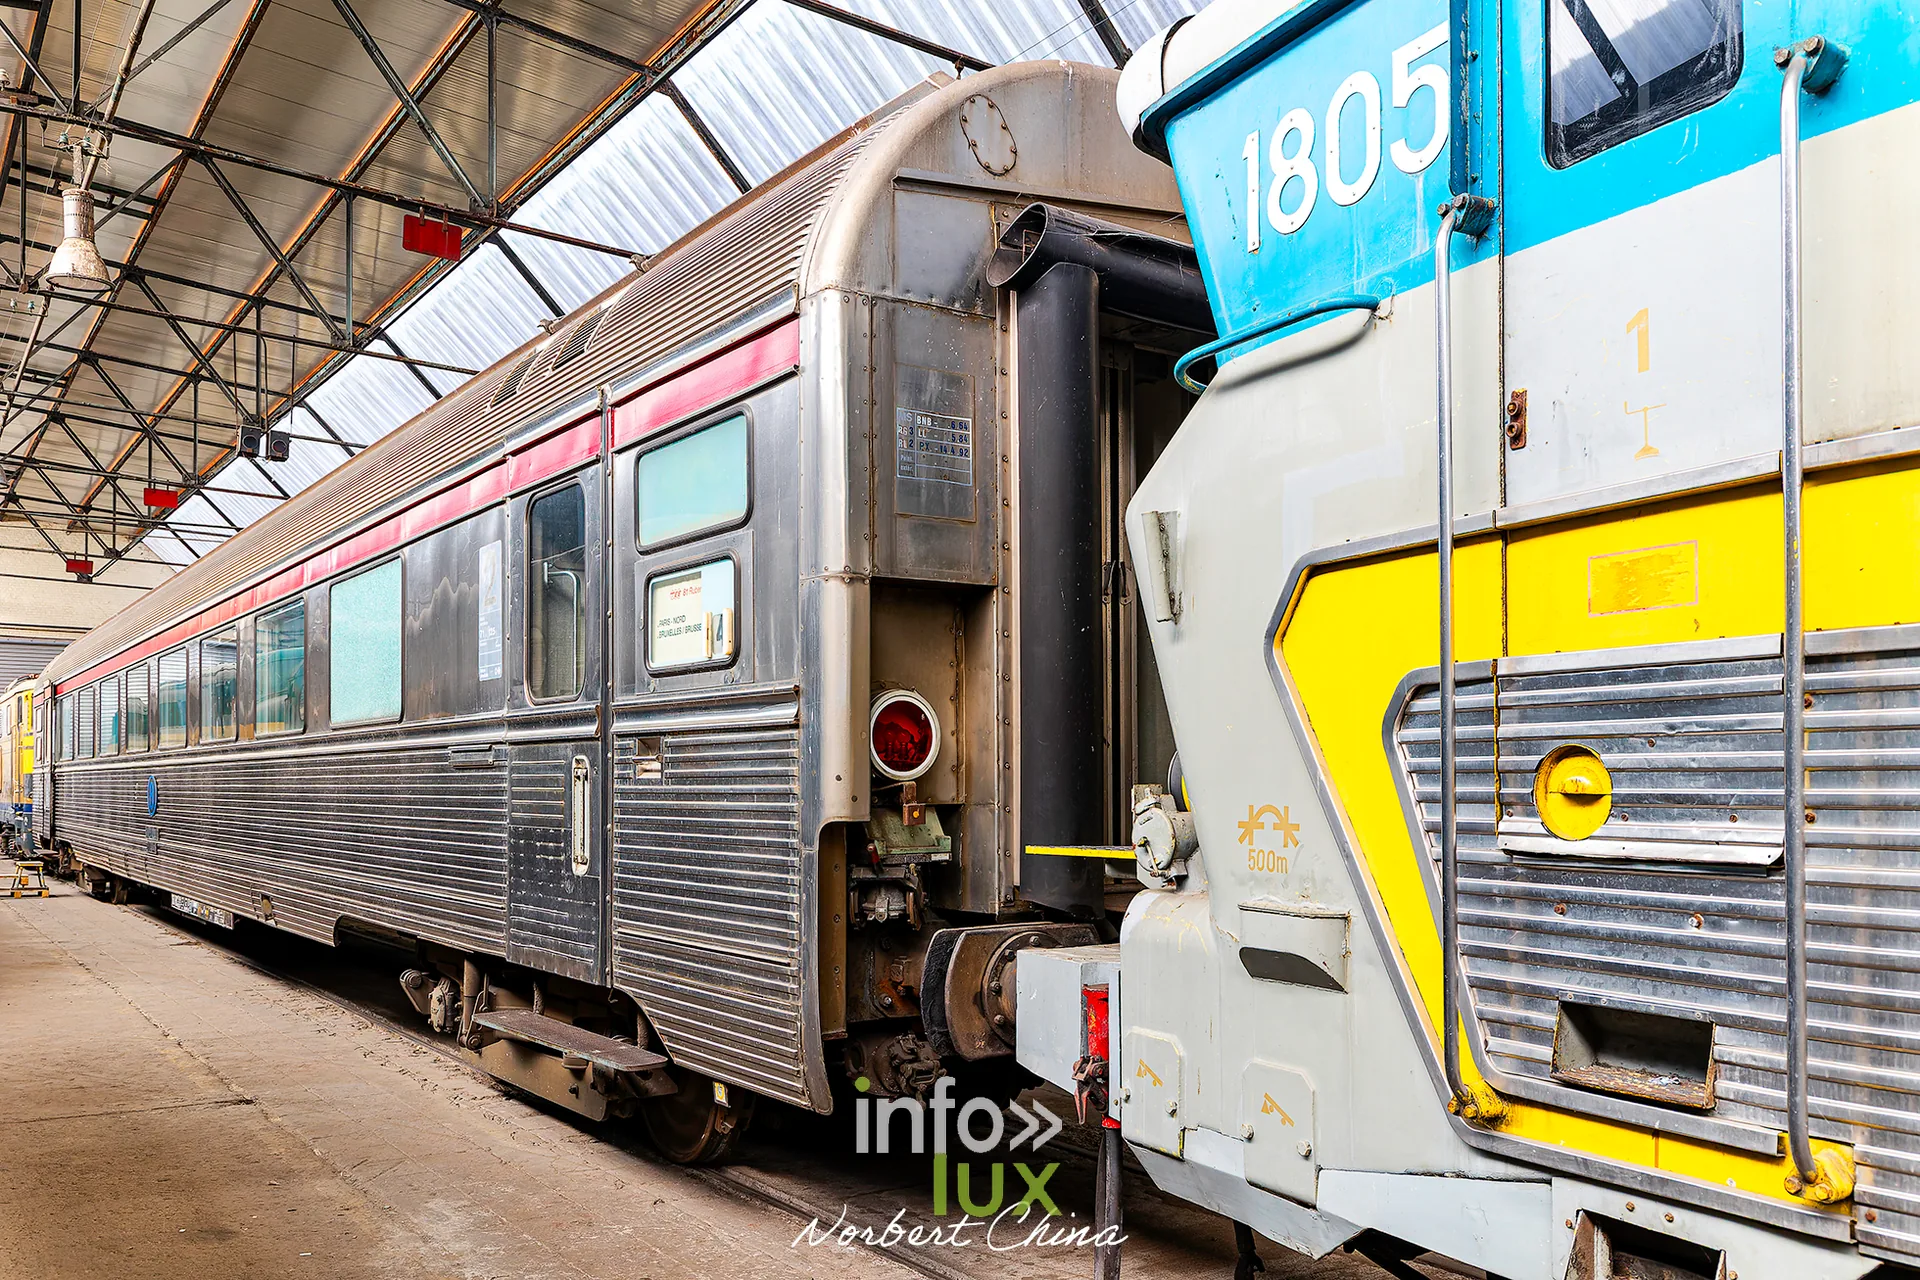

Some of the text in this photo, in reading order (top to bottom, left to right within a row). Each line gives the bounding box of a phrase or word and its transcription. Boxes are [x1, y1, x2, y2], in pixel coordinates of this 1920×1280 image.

[1242, 20, 1449, 253] 1805
[1626, 307, 1649, 373] 1
[1248, 848, 1288, 874] 500m
